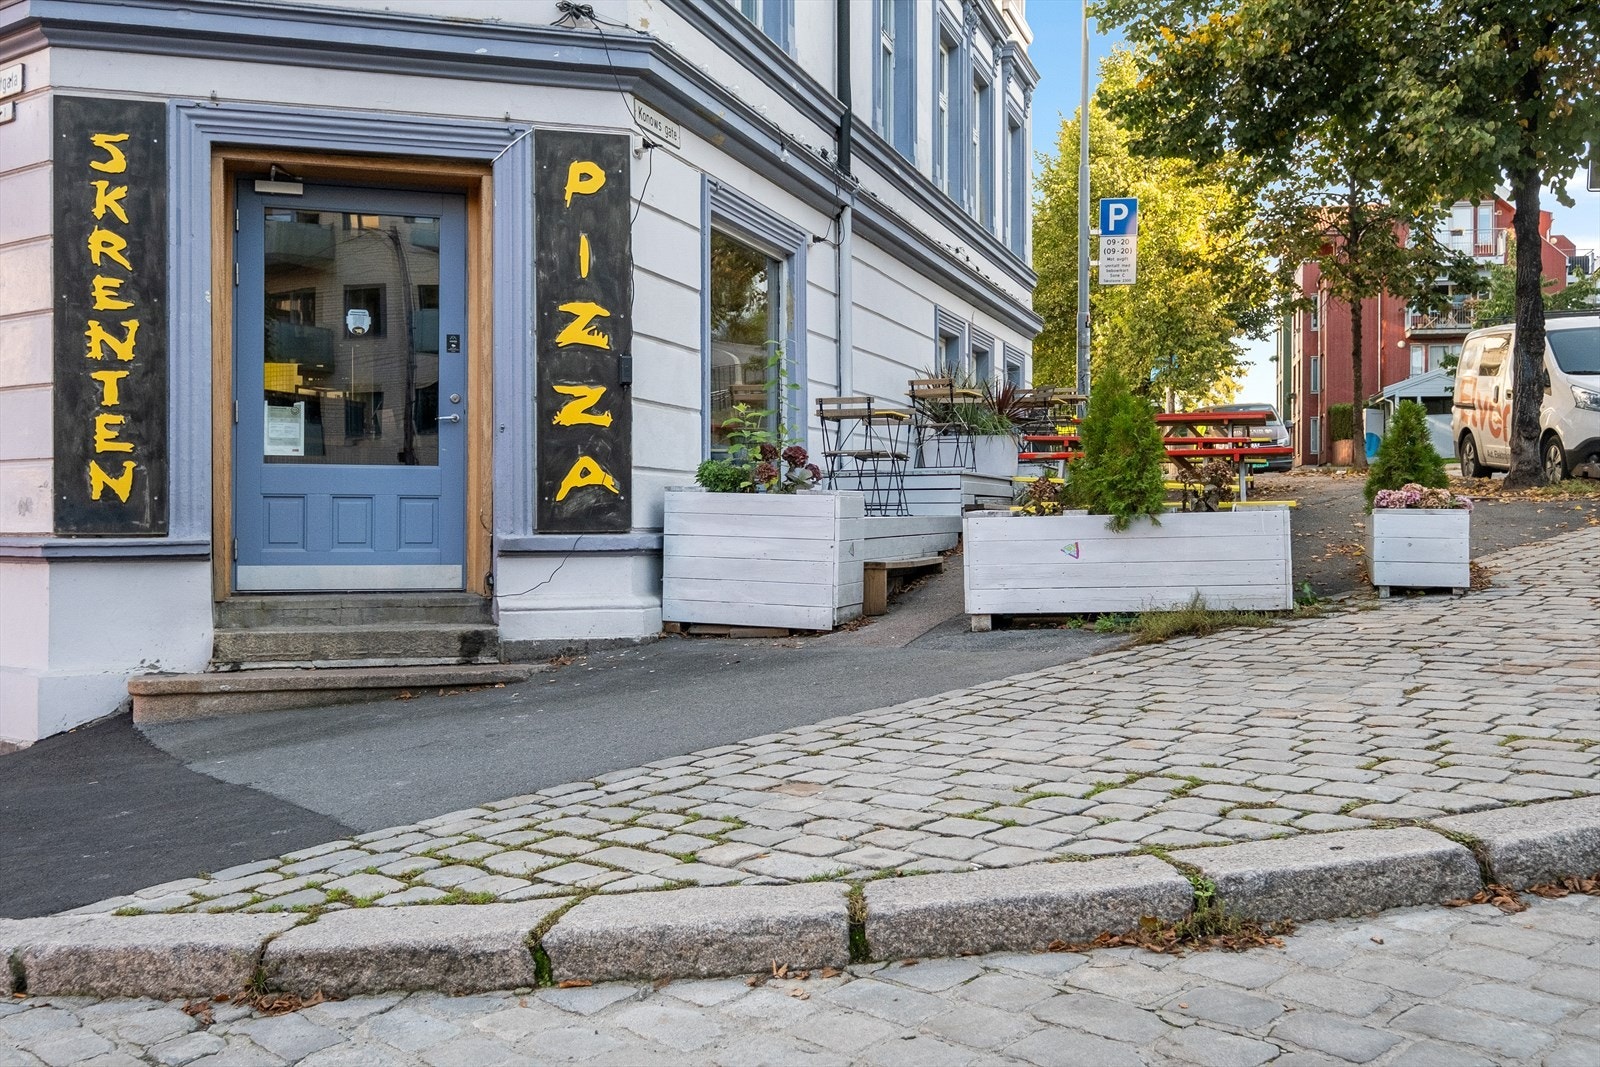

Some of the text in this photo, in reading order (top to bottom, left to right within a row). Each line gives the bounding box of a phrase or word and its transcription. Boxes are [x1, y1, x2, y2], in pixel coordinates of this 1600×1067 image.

[638, 105, 678, 141] Konows gate
[1109, 203, 1129, 231] P
[86, 133, 138, 503] SKRENTEN
[552, 160, 619, 502] PIZZA
